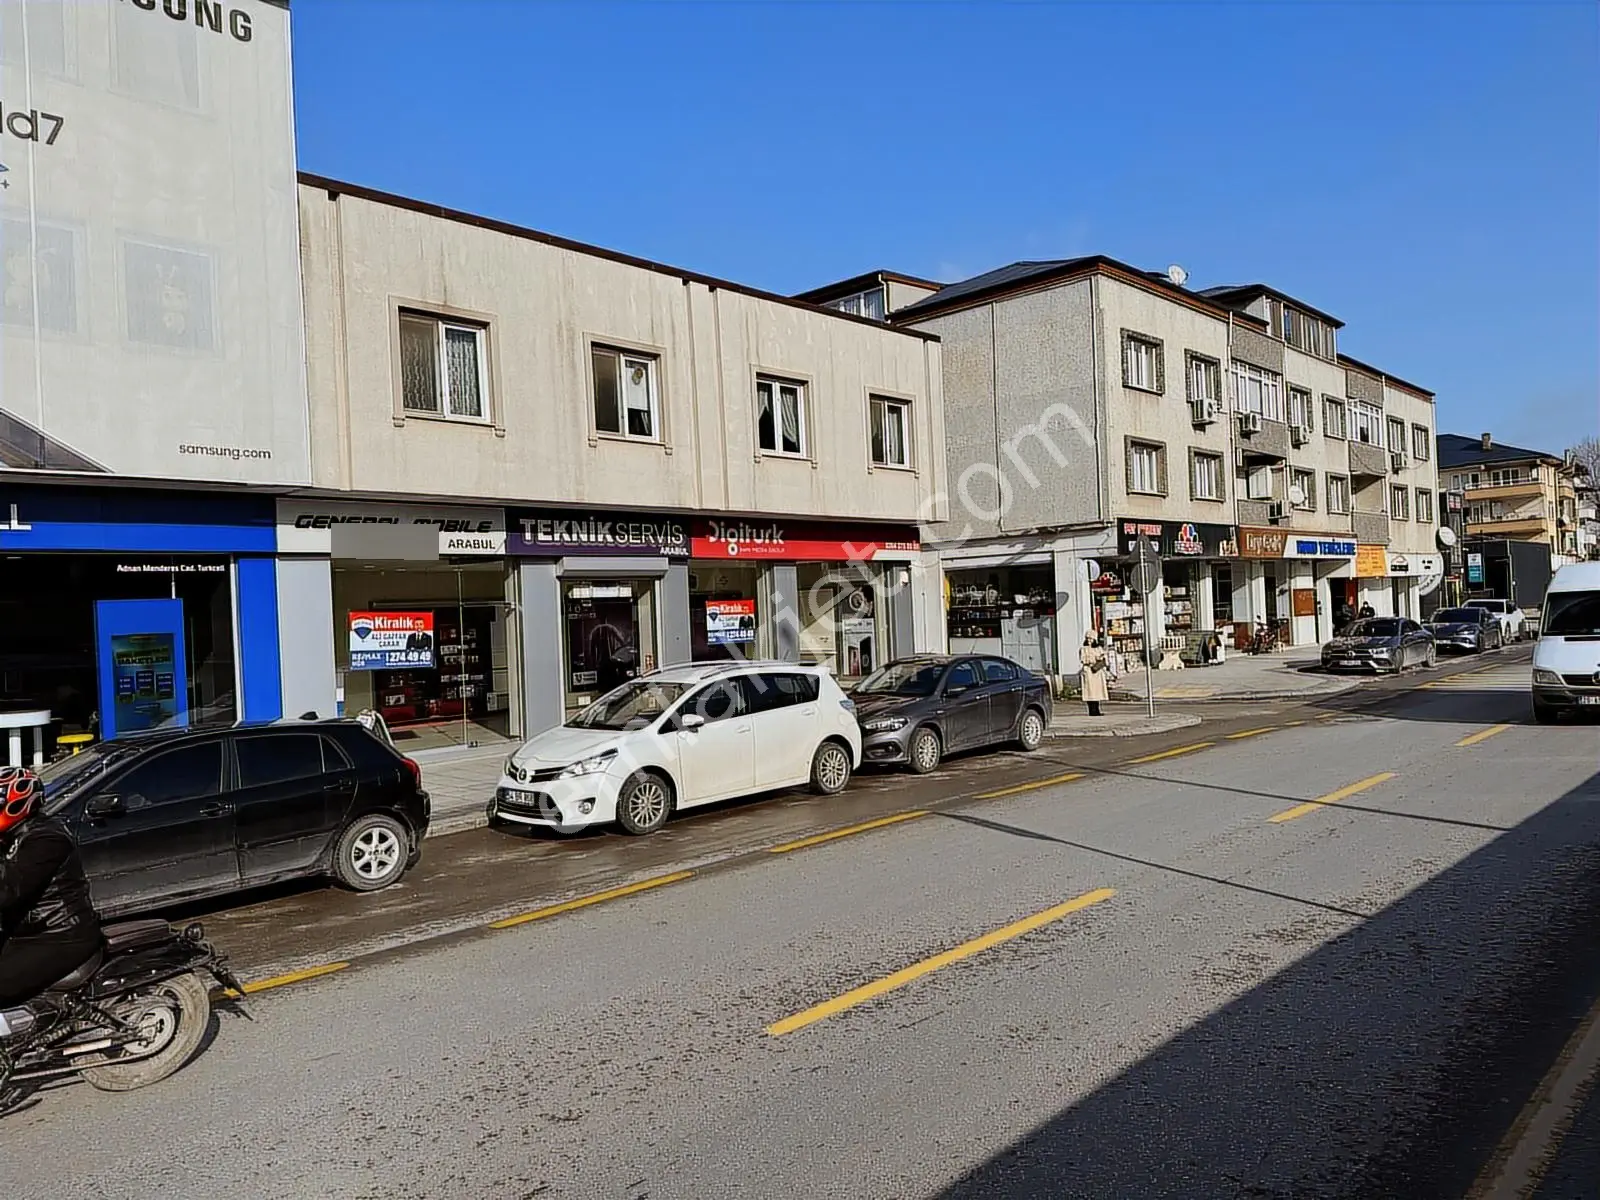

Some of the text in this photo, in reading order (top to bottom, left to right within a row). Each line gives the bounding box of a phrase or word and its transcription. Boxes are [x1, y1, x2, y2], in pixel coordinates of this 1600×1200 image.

[179, 442, 272, 460] samsung.com
[448, 538, 496, 550] ARABUL
[374, 616, 414, 629] Kiralık
